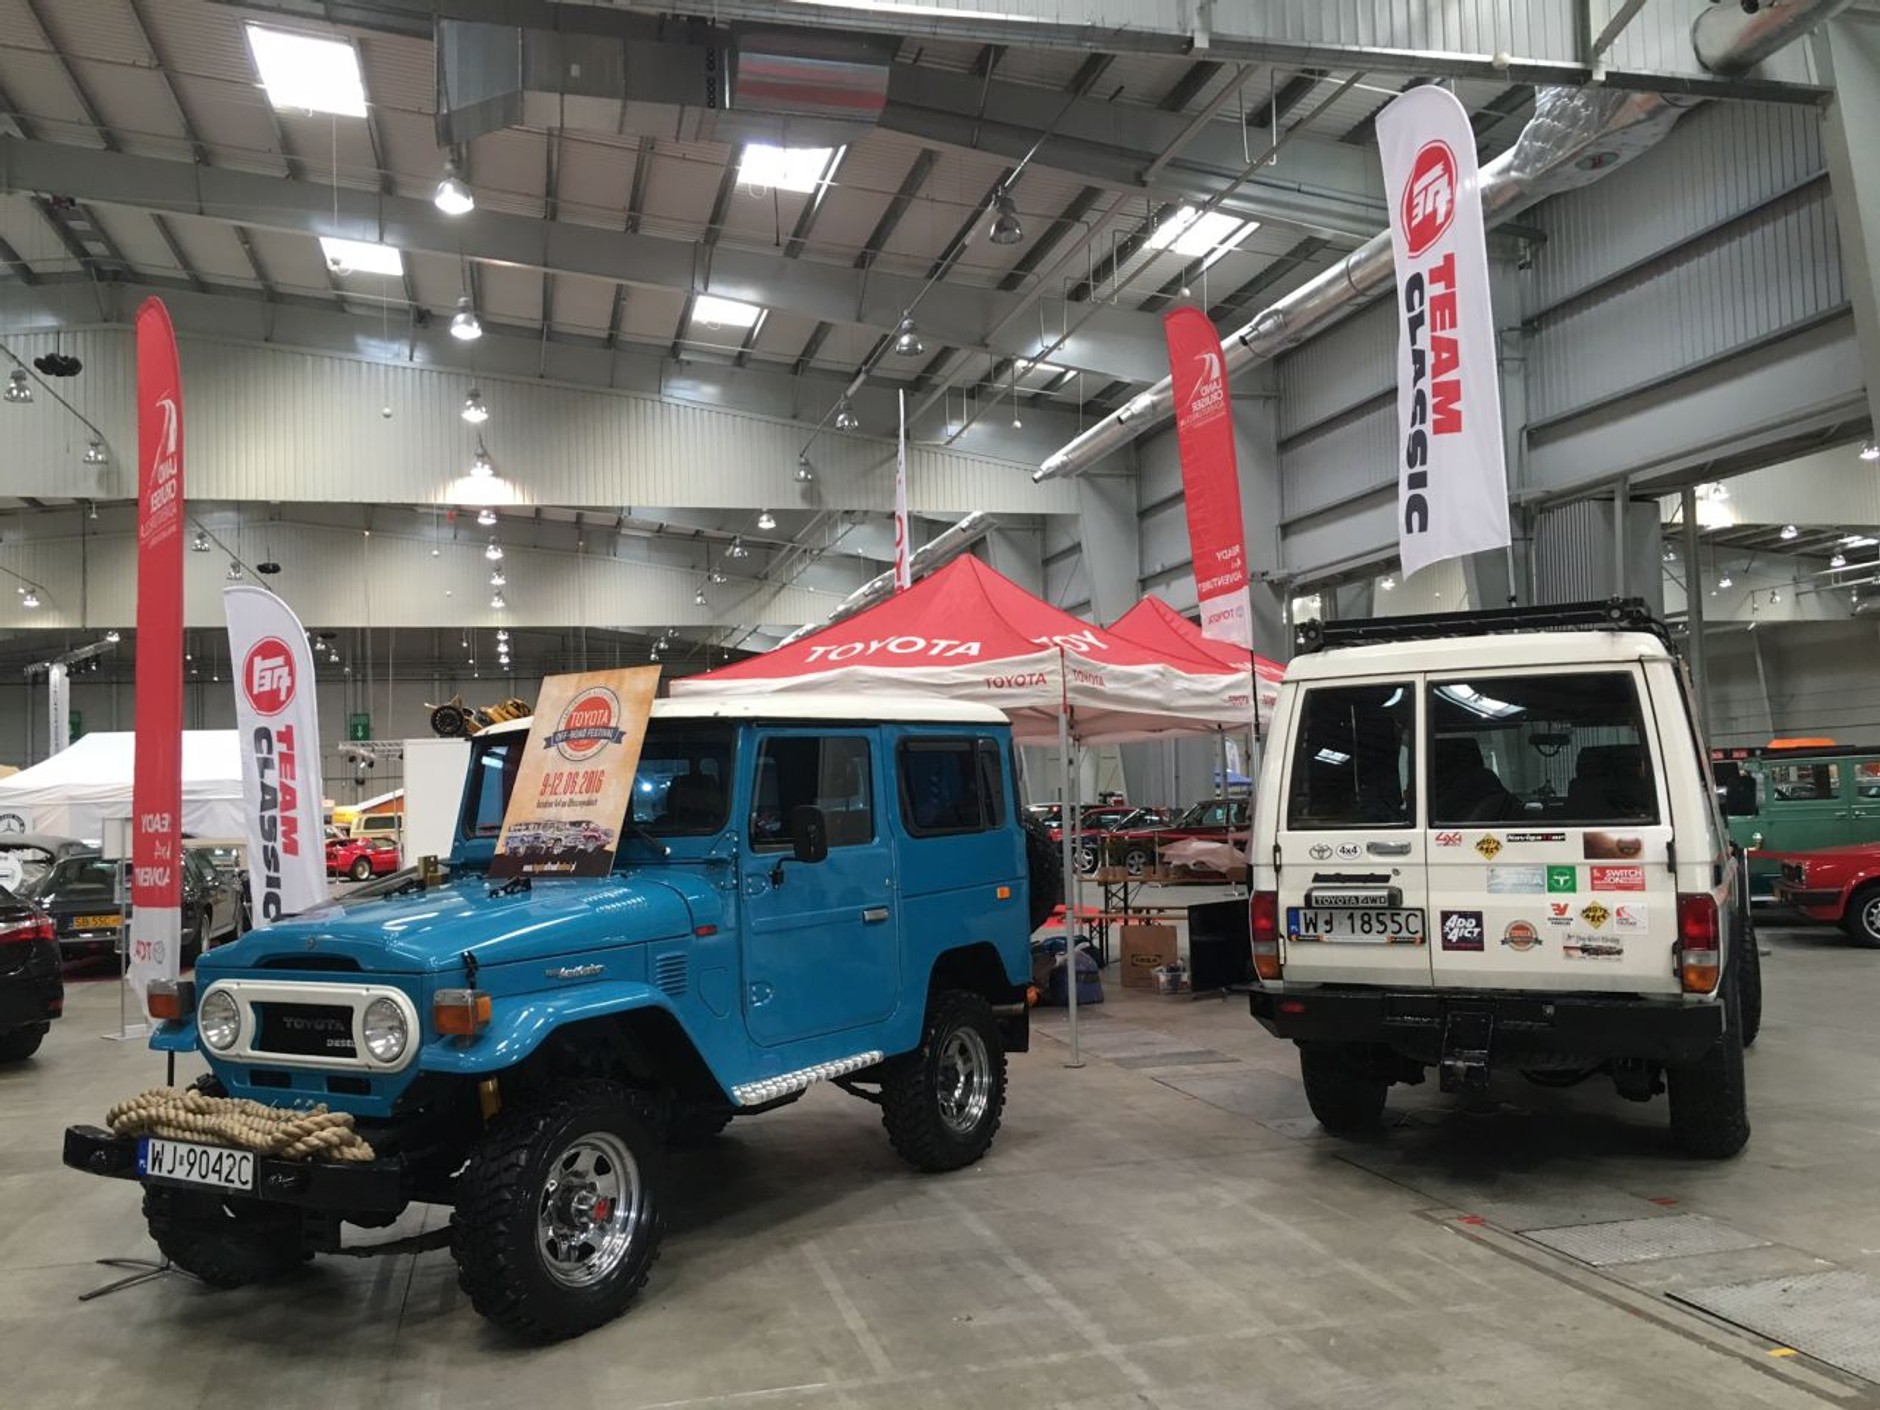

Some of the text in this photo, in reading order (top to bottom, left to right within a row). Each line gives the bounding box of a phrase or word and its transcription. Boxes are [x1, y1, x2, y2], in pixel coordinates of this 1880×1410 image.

[1428, 253, 1462, 436] TEAM
[1404, 271, 1429, 536] CLASSIC
[804, 636, 981, 663] TOYOTA
[985, 672, 1047, 689] TOYOTA
[1071, 669, 1105, 687] TOYOTA
[570, 709, 609, 727] TOYOTA
[275, 724, 299, 857] TEAM
[253, 725, 282, 923] CLASSIC
[1339, 845, 1358, 855] 4x4
[1605, 869, 1642, 878] SWITCH
[1314, 895, 1388, 905] TOYOTA 4WD
[1303, 911, 1419, 935] WJ 1855C
[281, 1017, 344, 1031] TOYOTA
[151, 1142, 251, 1186] WJ 9042C
